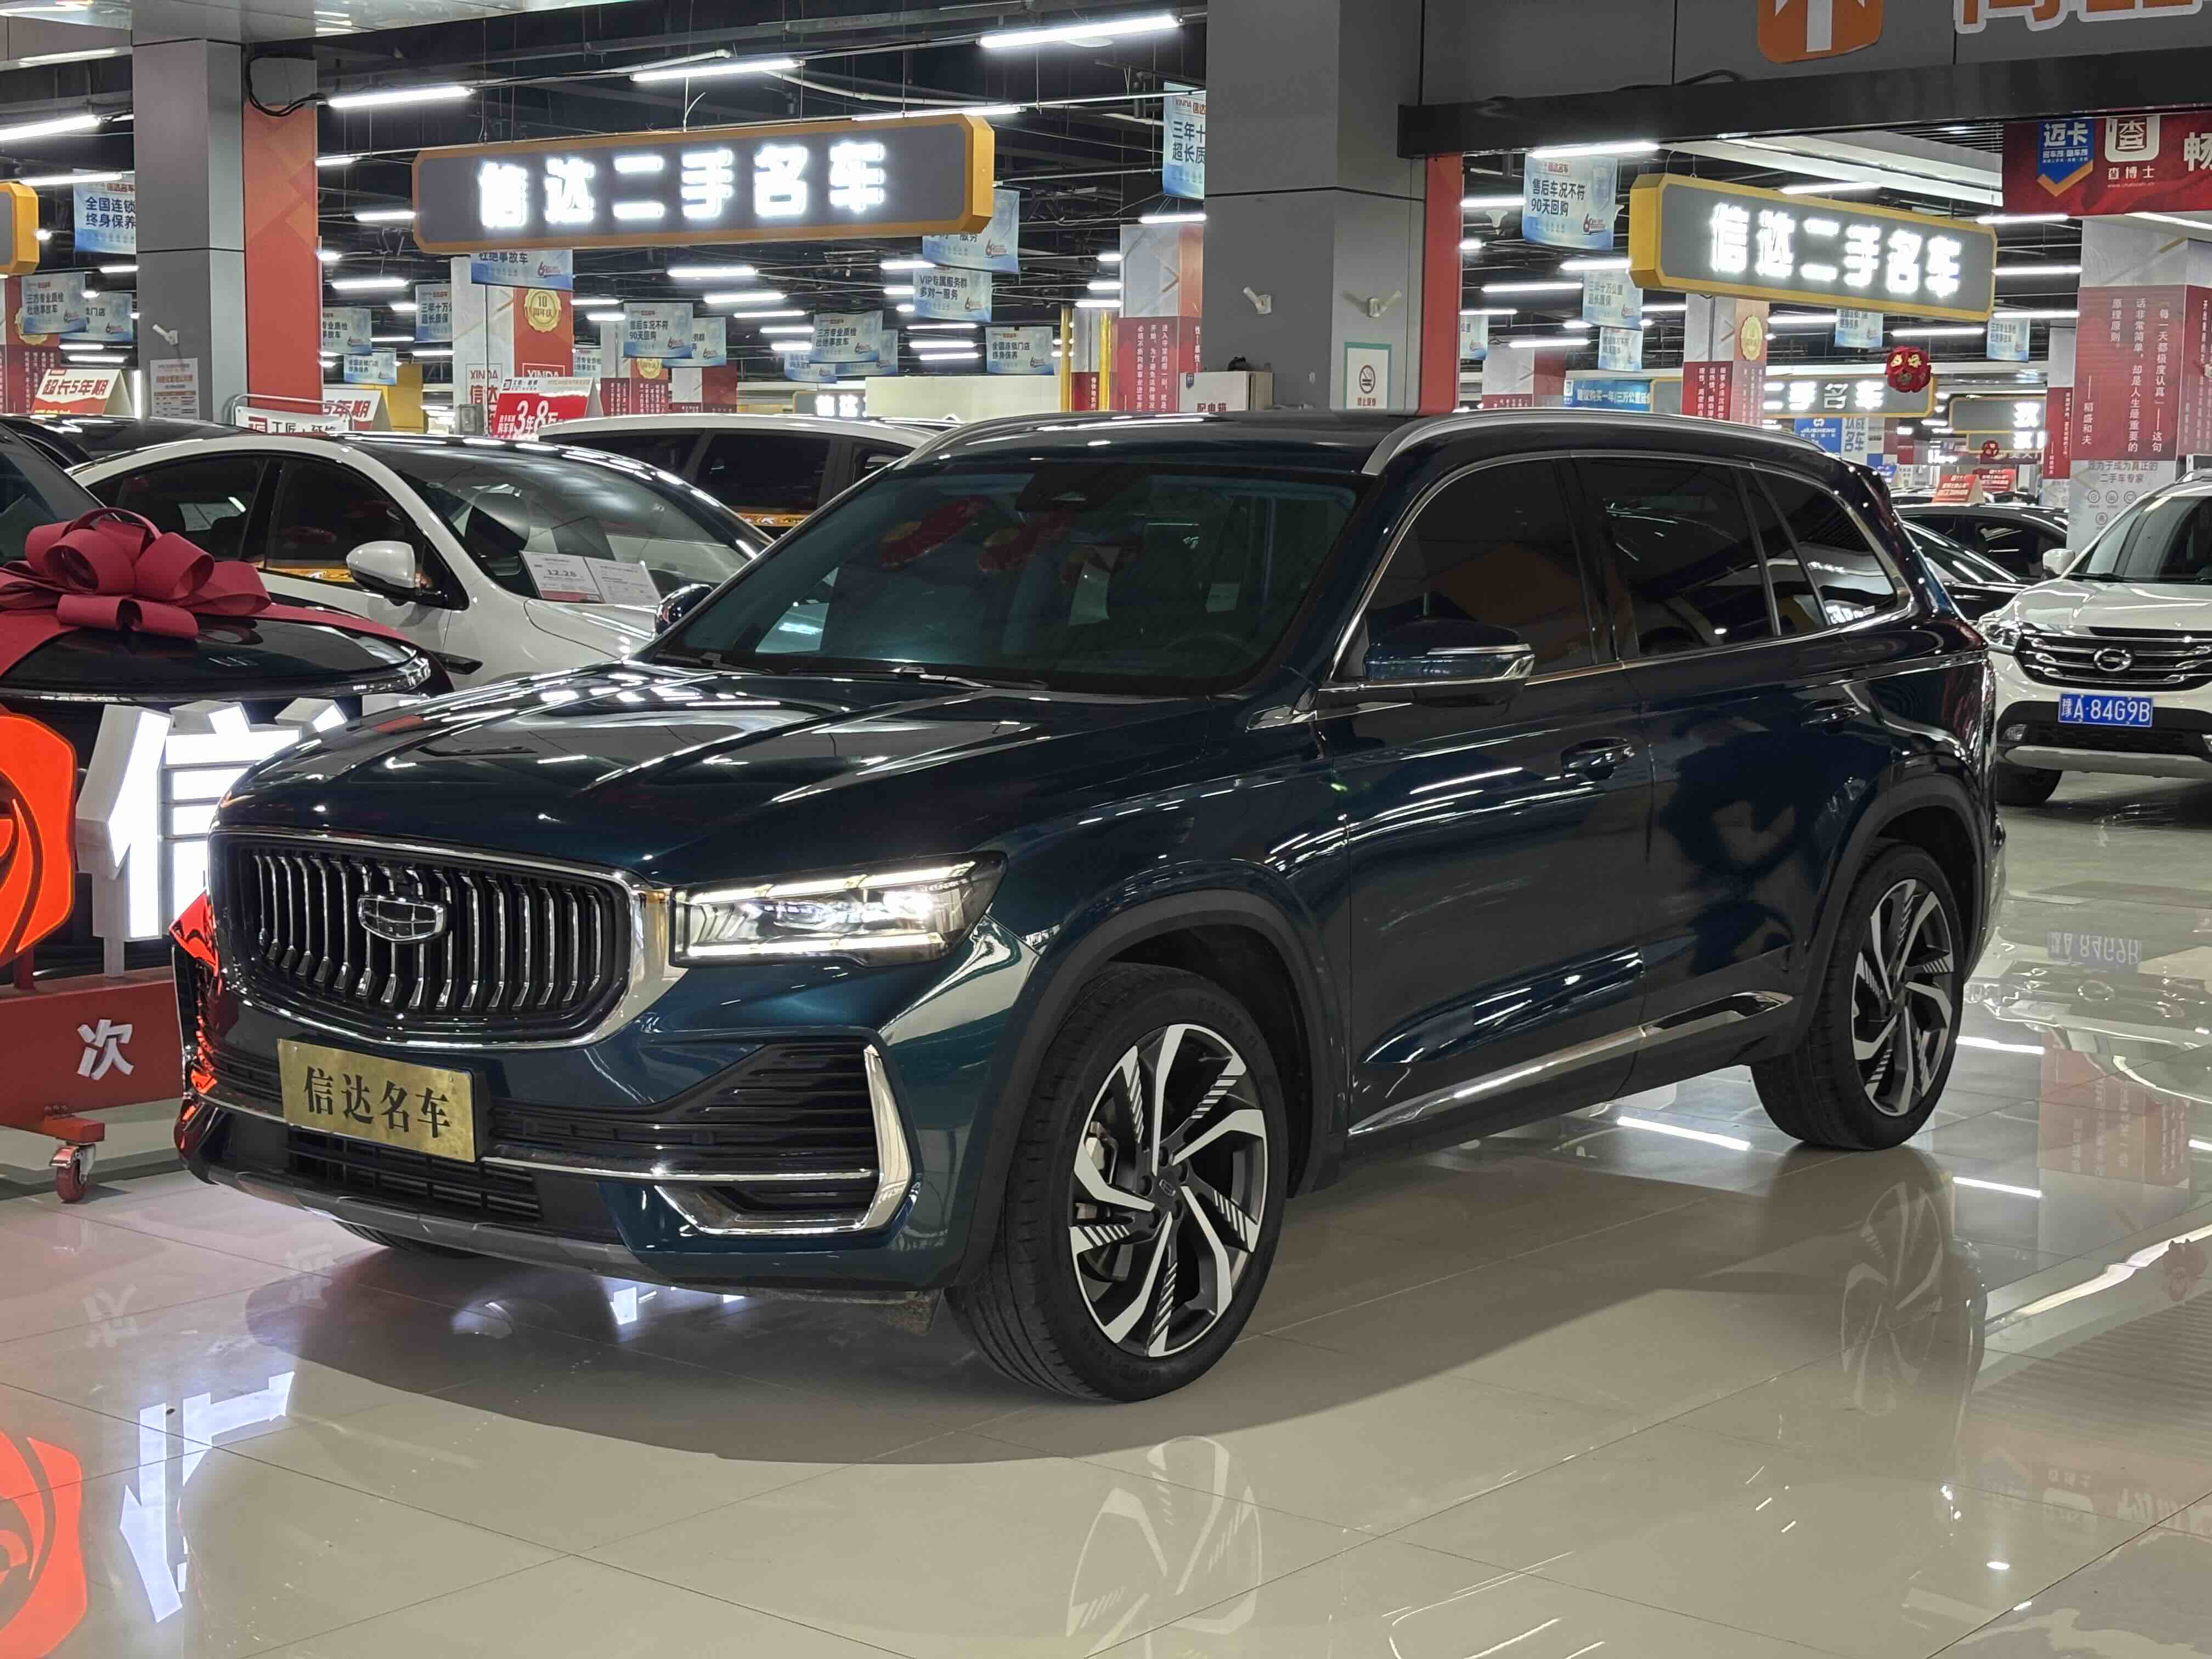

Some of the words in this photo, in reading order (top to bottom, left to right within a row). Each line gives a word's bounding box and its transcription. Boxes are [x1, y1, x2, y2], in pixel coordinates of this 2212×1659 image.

[2044, 121, 2089, 148] 迈卡
[478, 139, 887, 228] 信达二手名车
[2107, 165, 2155, 180] 查博士
[1532, 178, 1585, 201] 售后车况不符
[86, 196, 136, 213] 全国连锁
[1531, 198, 1569, 217] 90天回购
[86, 212, 136, 229] 终身保养
[1709, 201, 1962, 298] 信达二手名车
[538, 296, 548, 307] 10
[815, 394, 867, 417] 信达
[77, 1019, 135, 1081] 次
[303, 1065, 452, 1139] 信达名车
